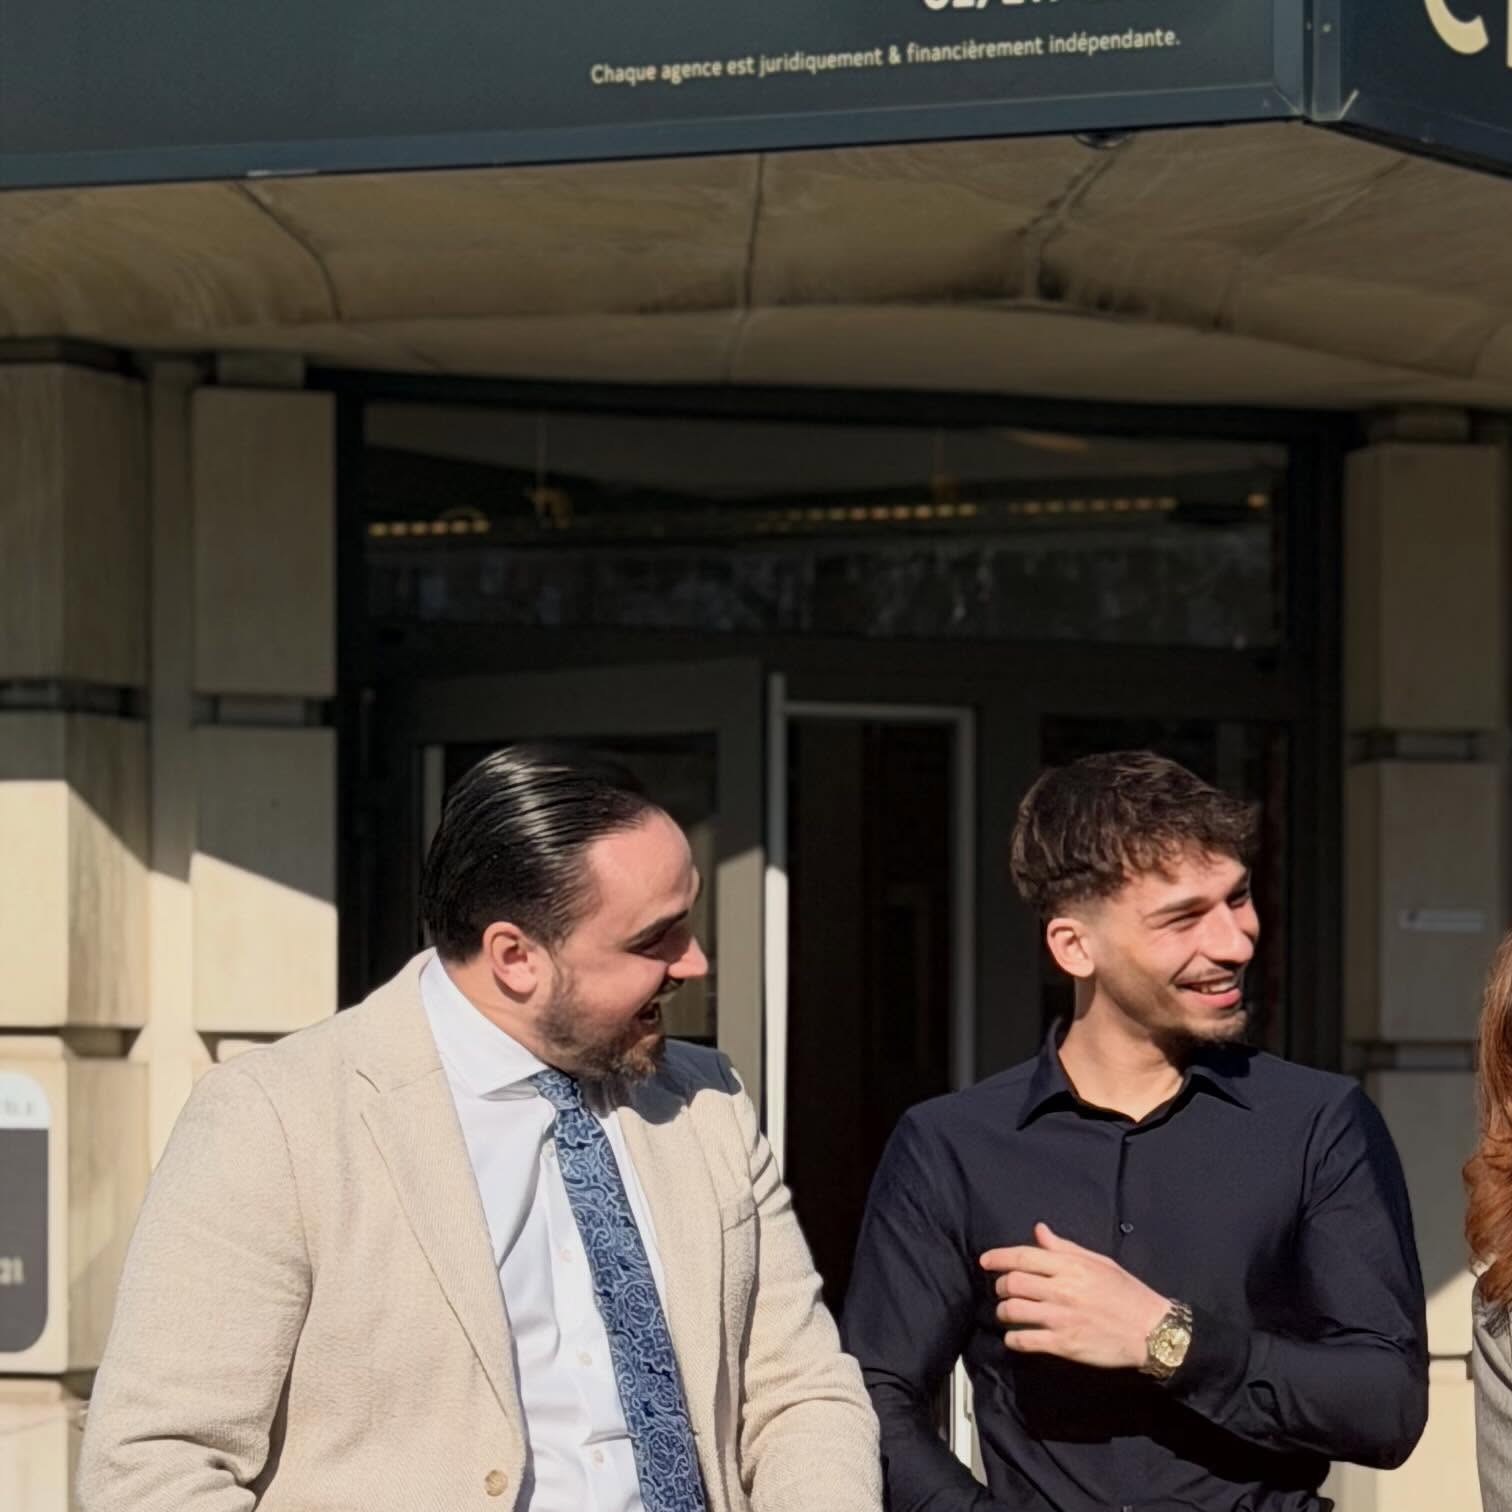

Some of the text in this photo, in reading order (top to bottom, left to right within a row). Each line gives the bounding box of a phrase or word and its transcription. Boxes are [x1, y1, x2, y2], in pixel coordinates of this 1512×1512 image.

[590, 27, 1181, 87] Chaque agence est juridiquement & financièrement indépendante.
